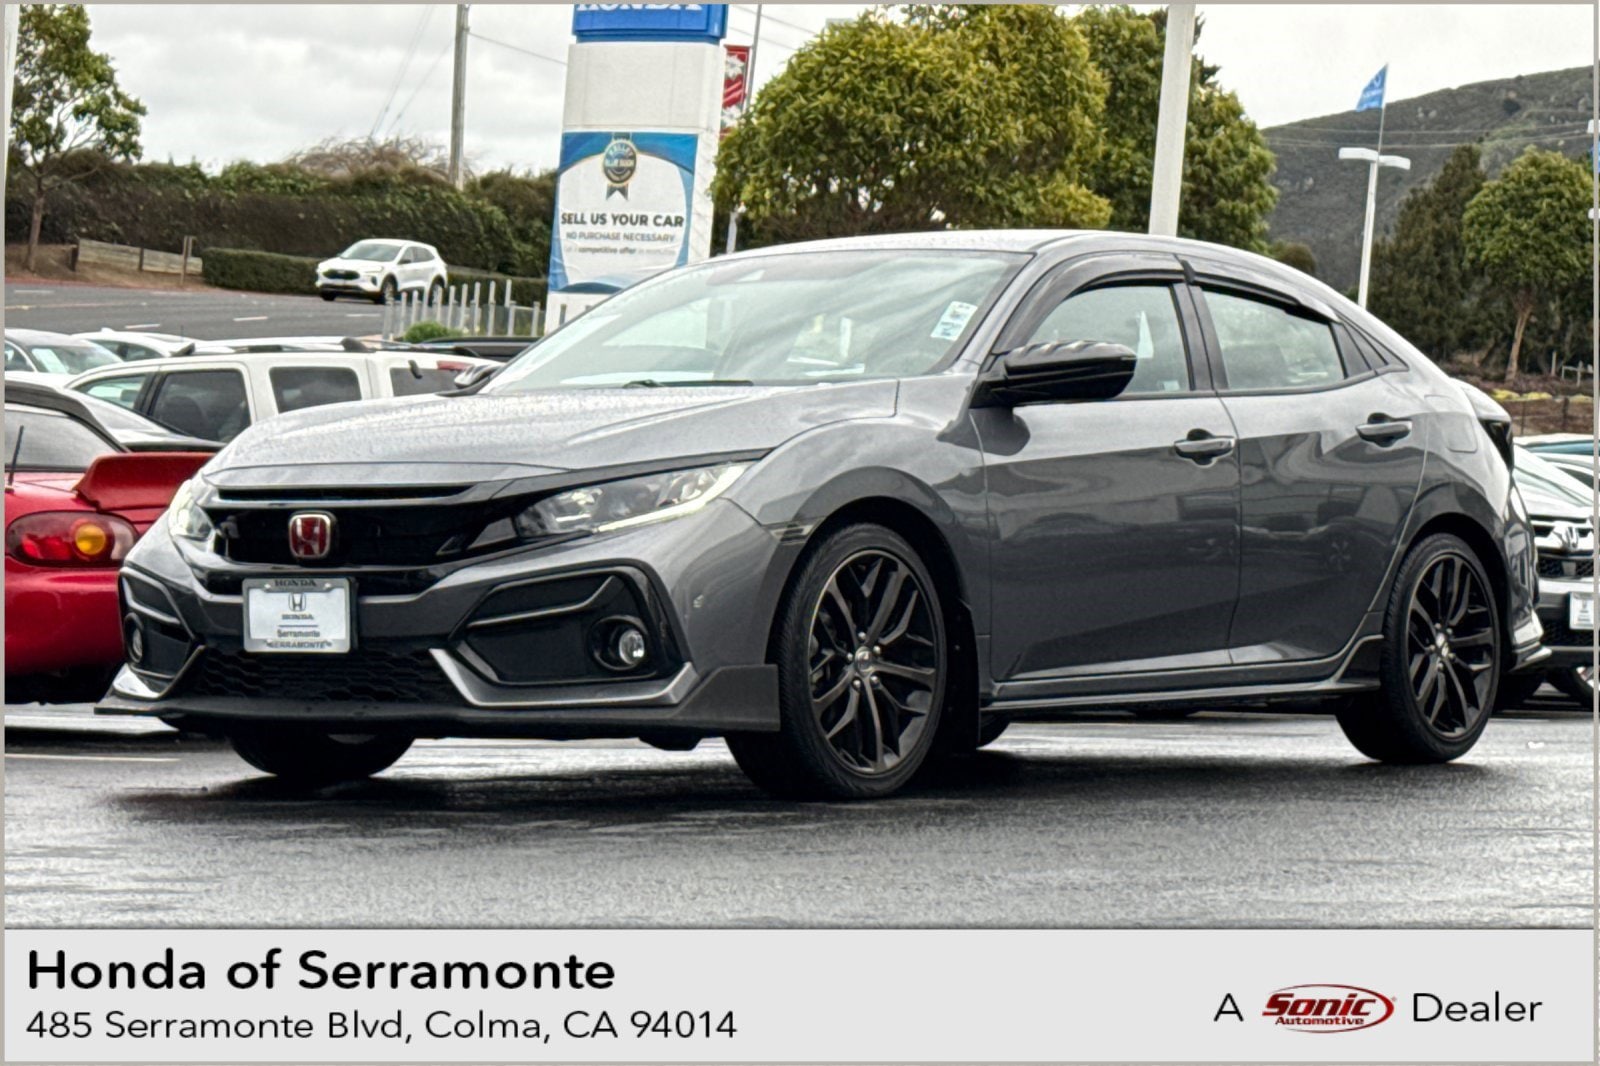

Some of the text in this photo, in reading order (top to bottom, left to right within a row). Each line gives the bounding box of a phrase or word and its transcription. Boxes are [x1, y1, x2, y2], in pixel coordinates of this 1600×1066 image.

[561, 212, 684, 227] SELL US YOUR CAR
[579, 231, 621, 241] PURCHASE
[623, 232, 675, 242] NECESSARY
[275, 579, 317, 587] HONDA
